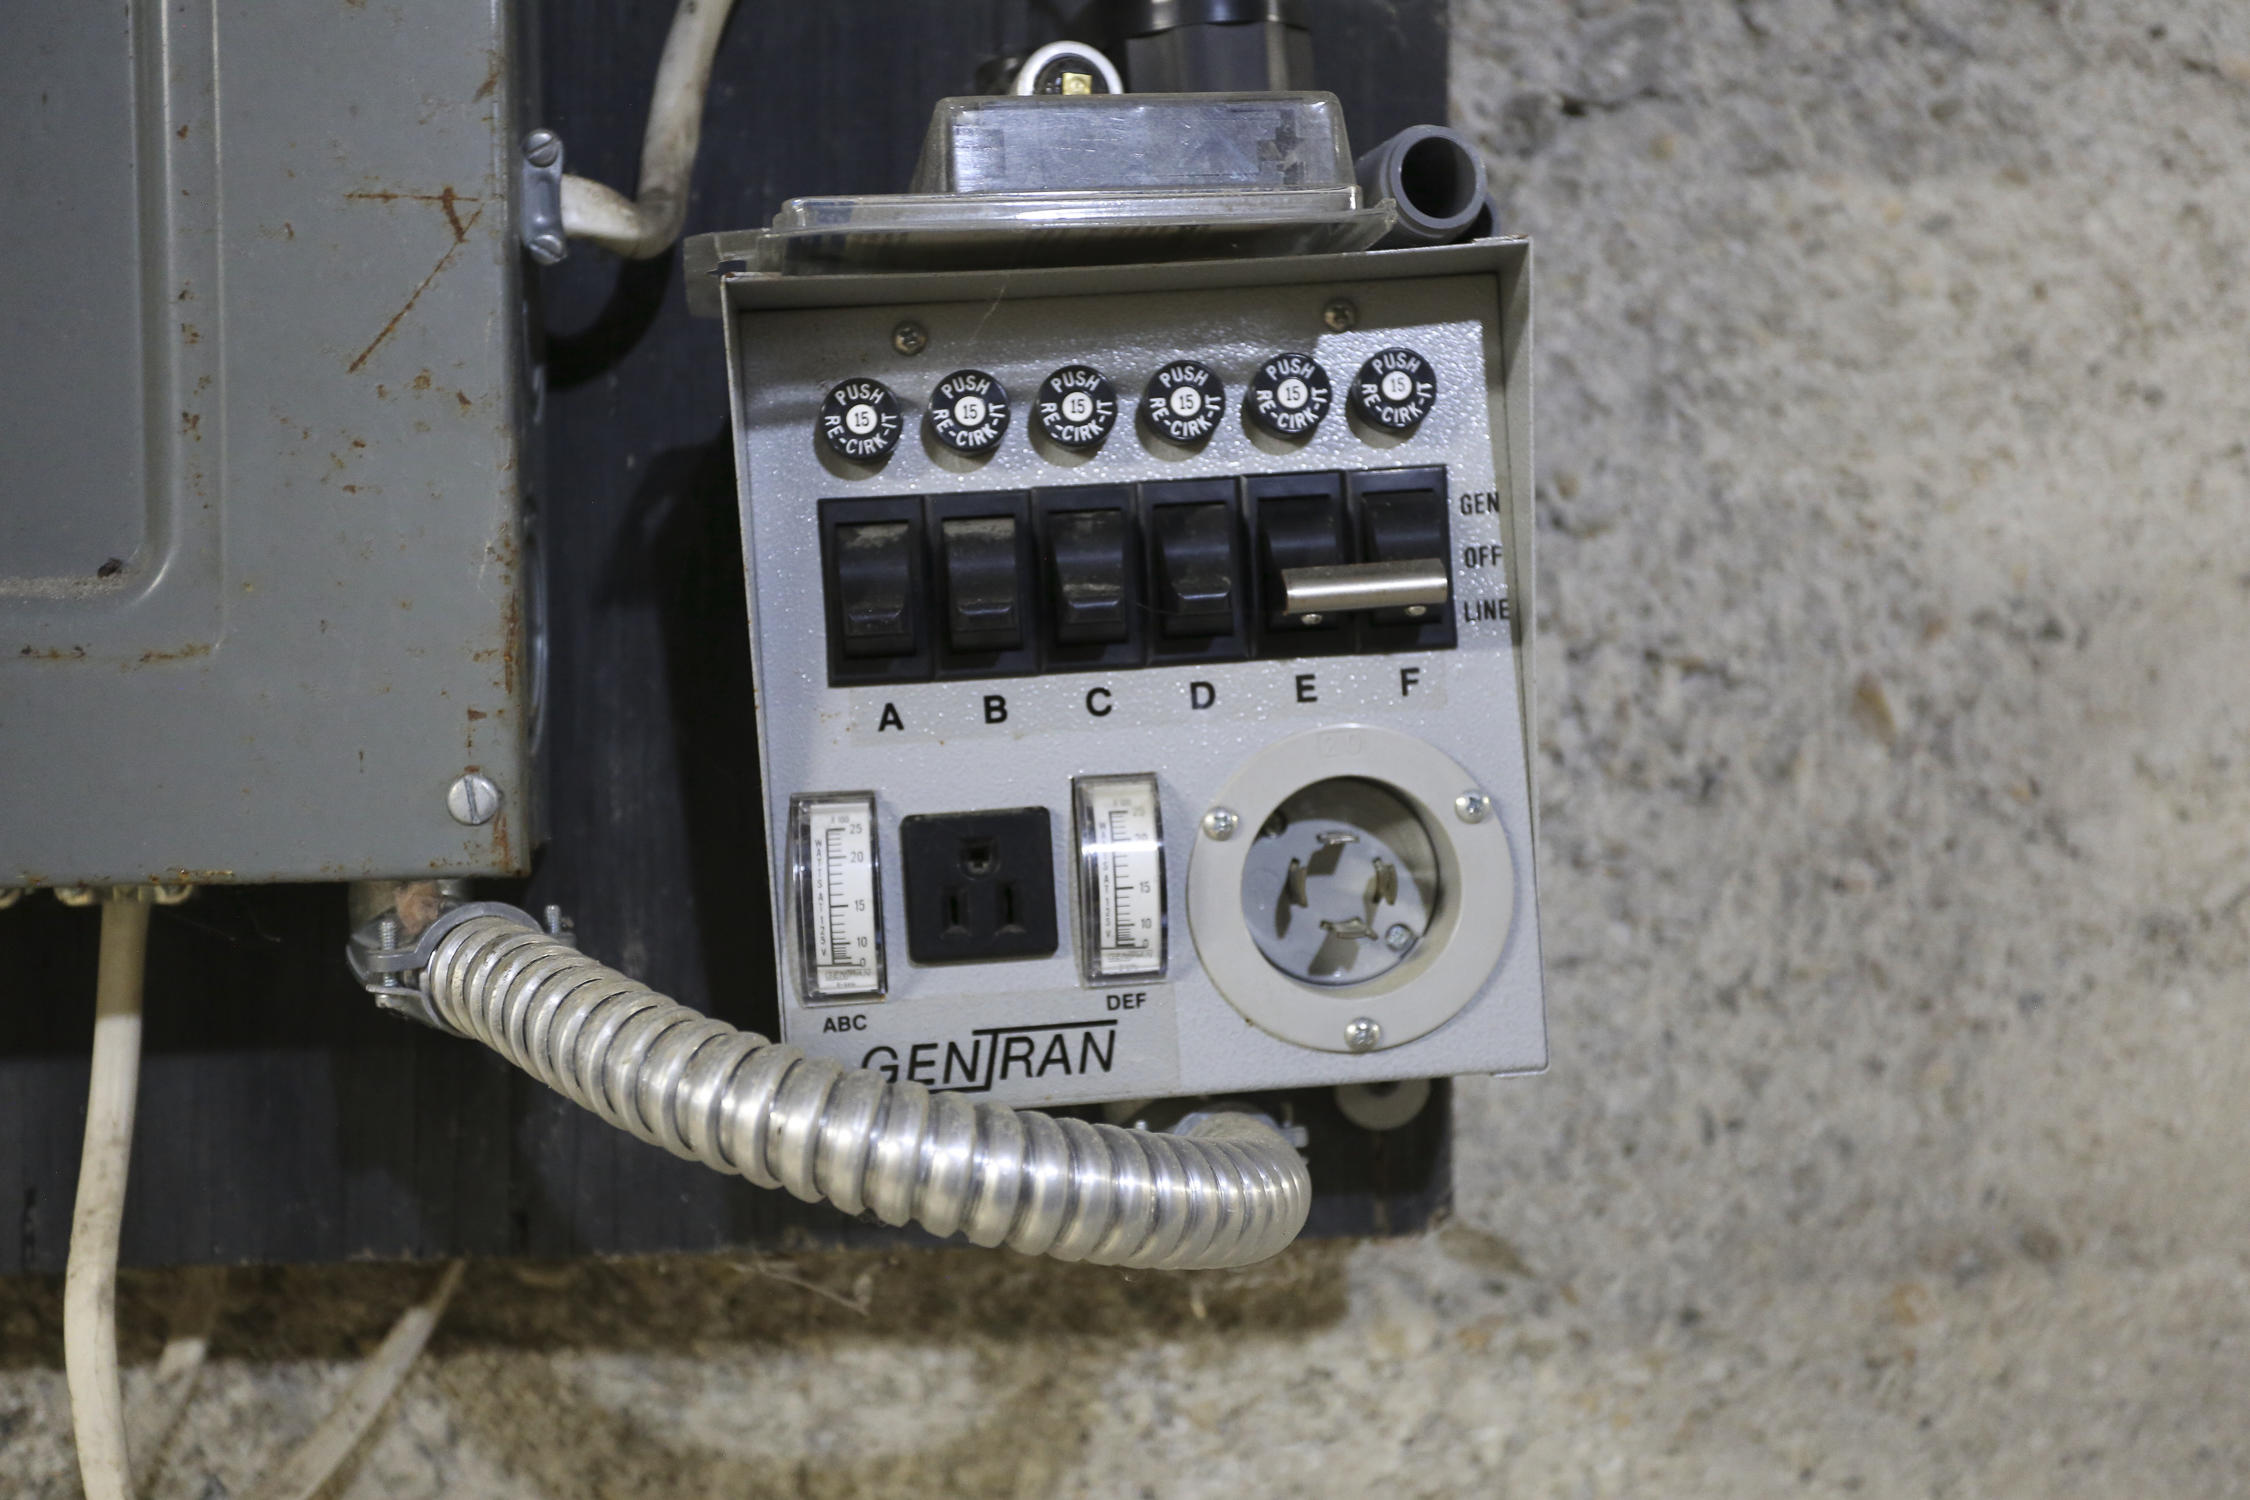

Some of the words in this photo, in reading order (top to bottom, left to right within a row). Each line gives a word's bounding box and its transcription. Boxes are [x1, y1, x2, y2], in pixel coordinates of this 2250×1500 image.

[1266, 359, 1316, 380] PUSH
[1372, 352, 1421, 374] PUSH
[1050, 370, 1100, 393] PUSH
[1159, 366, 1209, 388] PUSH
[1390, 378, 1405, 392] 15
[834, 383, 885, 406] PUSH
[942, 374, 991, 399] PUSH
[1286, 386, 1301, 402] 15
[1070, 398, 1086, 414] 15
[1179, 394, 1194, 410] 15
[855, 411, 870, 428] 15
[963, 404, 978, 420] 15
[1460, 492, 1499, 515] GEN
[1464, 546, 1503, 568] OFF
[1464, 598, 1510, 622] LINE
[878, 703, 905, 732] A
[984, 695, 1008, 723] B
[1085, 687, 1112, 717] C
[1190, 681, 1215, 710] D
[1295, 674, 1317, 703] E
[1400, 667, 1419, 696] F
[850, 823, 862, 834] 25
[850, 851, 864, 863] 20
[1138, 880, 1151, 894] 15
[854, 899, 865, 911] 15
[1140, 918, 1152, 929] 10
[857, 936, 868, 947] 10
[859, 957, 867, 967] 0
[1106, 993, 1147, 1011] DEF
[823, 1014, 868, 1033] ABC
[861, 1019, 1118, 1092] GENTRAN
